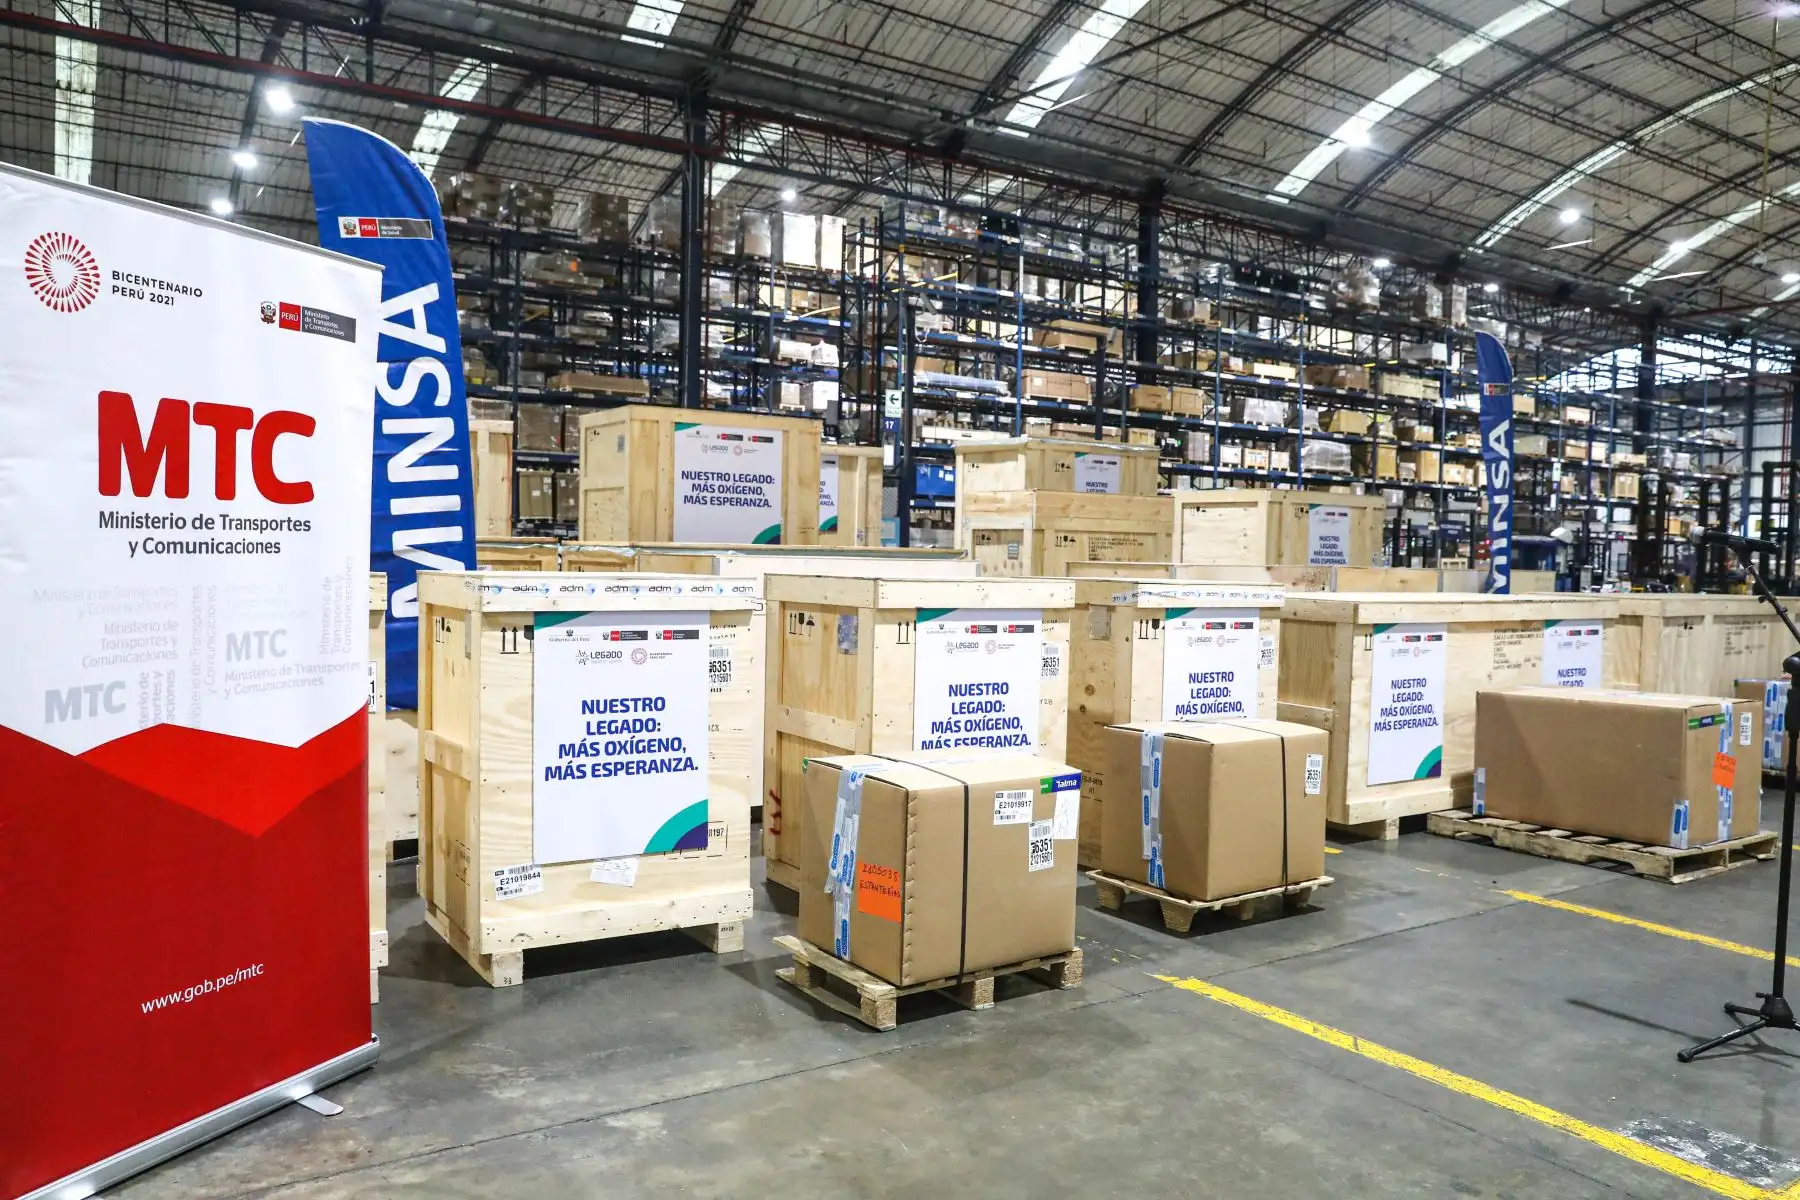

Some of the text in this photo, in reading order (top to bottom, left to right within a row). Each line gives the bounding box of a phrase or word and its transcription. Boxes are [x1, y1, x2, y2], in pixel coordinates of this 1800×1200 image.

[112, 269, 204, 299] BICENTENARIO
[112, 284, 175, 307] PERÚ 2021
[281, 311, 299, 322] PERÚ
[884, 420, 895, 430] 17
[97, 390, 317, 504] MTC
[681, 470, 776, 485] NUESTRO LEGADO:
[691, 482, 766, 497] MÁS OXÍGENO,
[683, 494, 772, 508] MÁS ESPERANZA.
[98, 510, 312, 535] Ministerio de Transportes
[128, 536, 282, 558] y Comunicaciones
[225, 628, 288, 664] MTC
[1188, 671, 1235, 684] NUESTRO
[1557, 668, 1587, 678] NUESTRO
[948, 682, 1010, 698] NUESTRO
[1391, 677, 1427, 690] NUESTRO
[1190, 687, 1232, 700] LEGADO:
[1392, 690, 1425, 703] LEGADO:
[43, 680, 127, 725] MTC
[581, 696, 666, 715] NUESTRO
[951, 701, 1006, 716] LEGADO:
[1175, 700, 1245, 716] MÁS OXÍGENO,
[1380, 702, 1435, 718] MÁS OXÍGENO,
[586, 717, 661, 736] LEGADO:
[931, 716, 1024, 735] MÁS OXÍGENO,
[1374, 716, 1440, 733] MÁS ESPERANZA.
[558, 736, 687, 760] MÁS OXÍGENO,
[544, 755, 699, 782] MÁS ESPERANZA.
[998, 800, 1032, 809] E21019917
[500, 871, 541, 887] E21019844
[141, 962, 264, 1014] www.gob.pe/mtc
